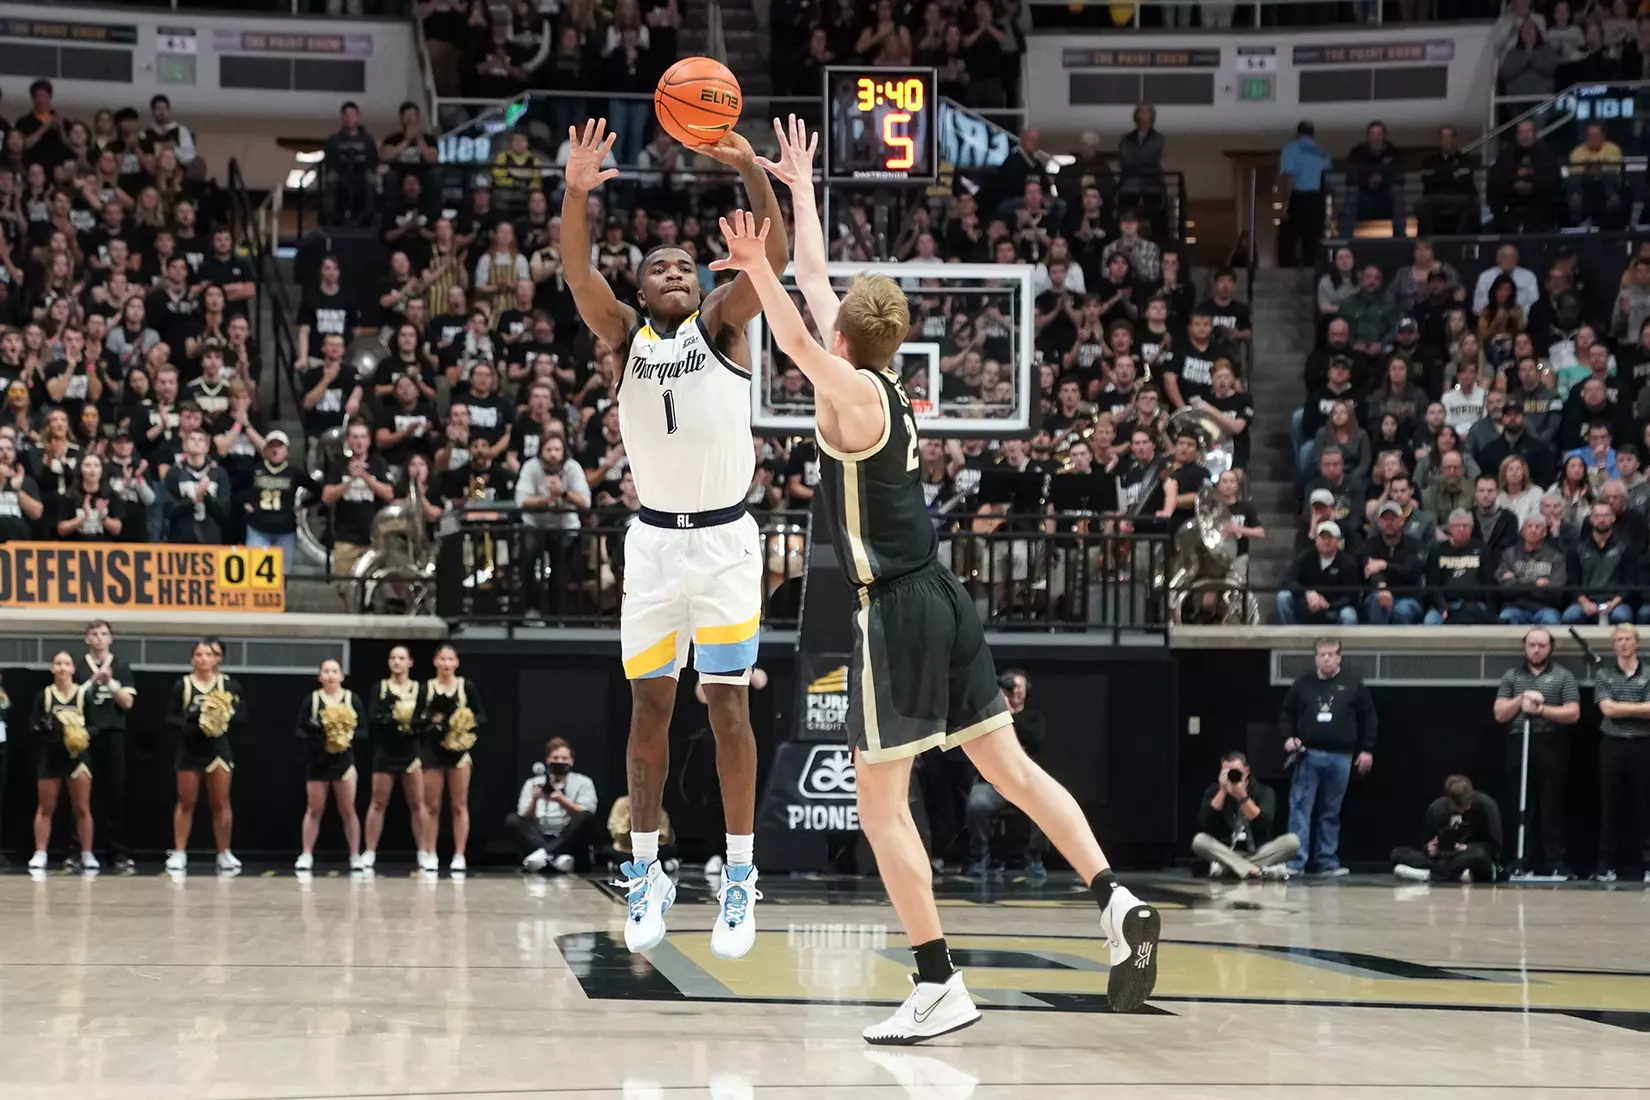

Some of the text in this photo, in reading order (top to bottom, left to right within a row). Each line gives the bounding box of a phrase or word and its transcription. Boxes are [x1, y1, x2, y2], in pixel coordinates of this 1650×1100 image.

[701, 89, 738, 109] ELITE
[857, 78, 923, 111] 3:40
[883, 113, 914, 169] 5
[853, 170, 908, 179] DAKTRONICS
[632, 349, 706, 385] Marquette
[662, 389, 677, 434] 1
[157, 552, 215, 576] LIVES
[1438, 555, 1480, 569] PURDUE
[0, 549, 153, 604] DEFENSE
[158, 579, 216, 606] HERE
[806, 723, 842, 731] CREDIT
